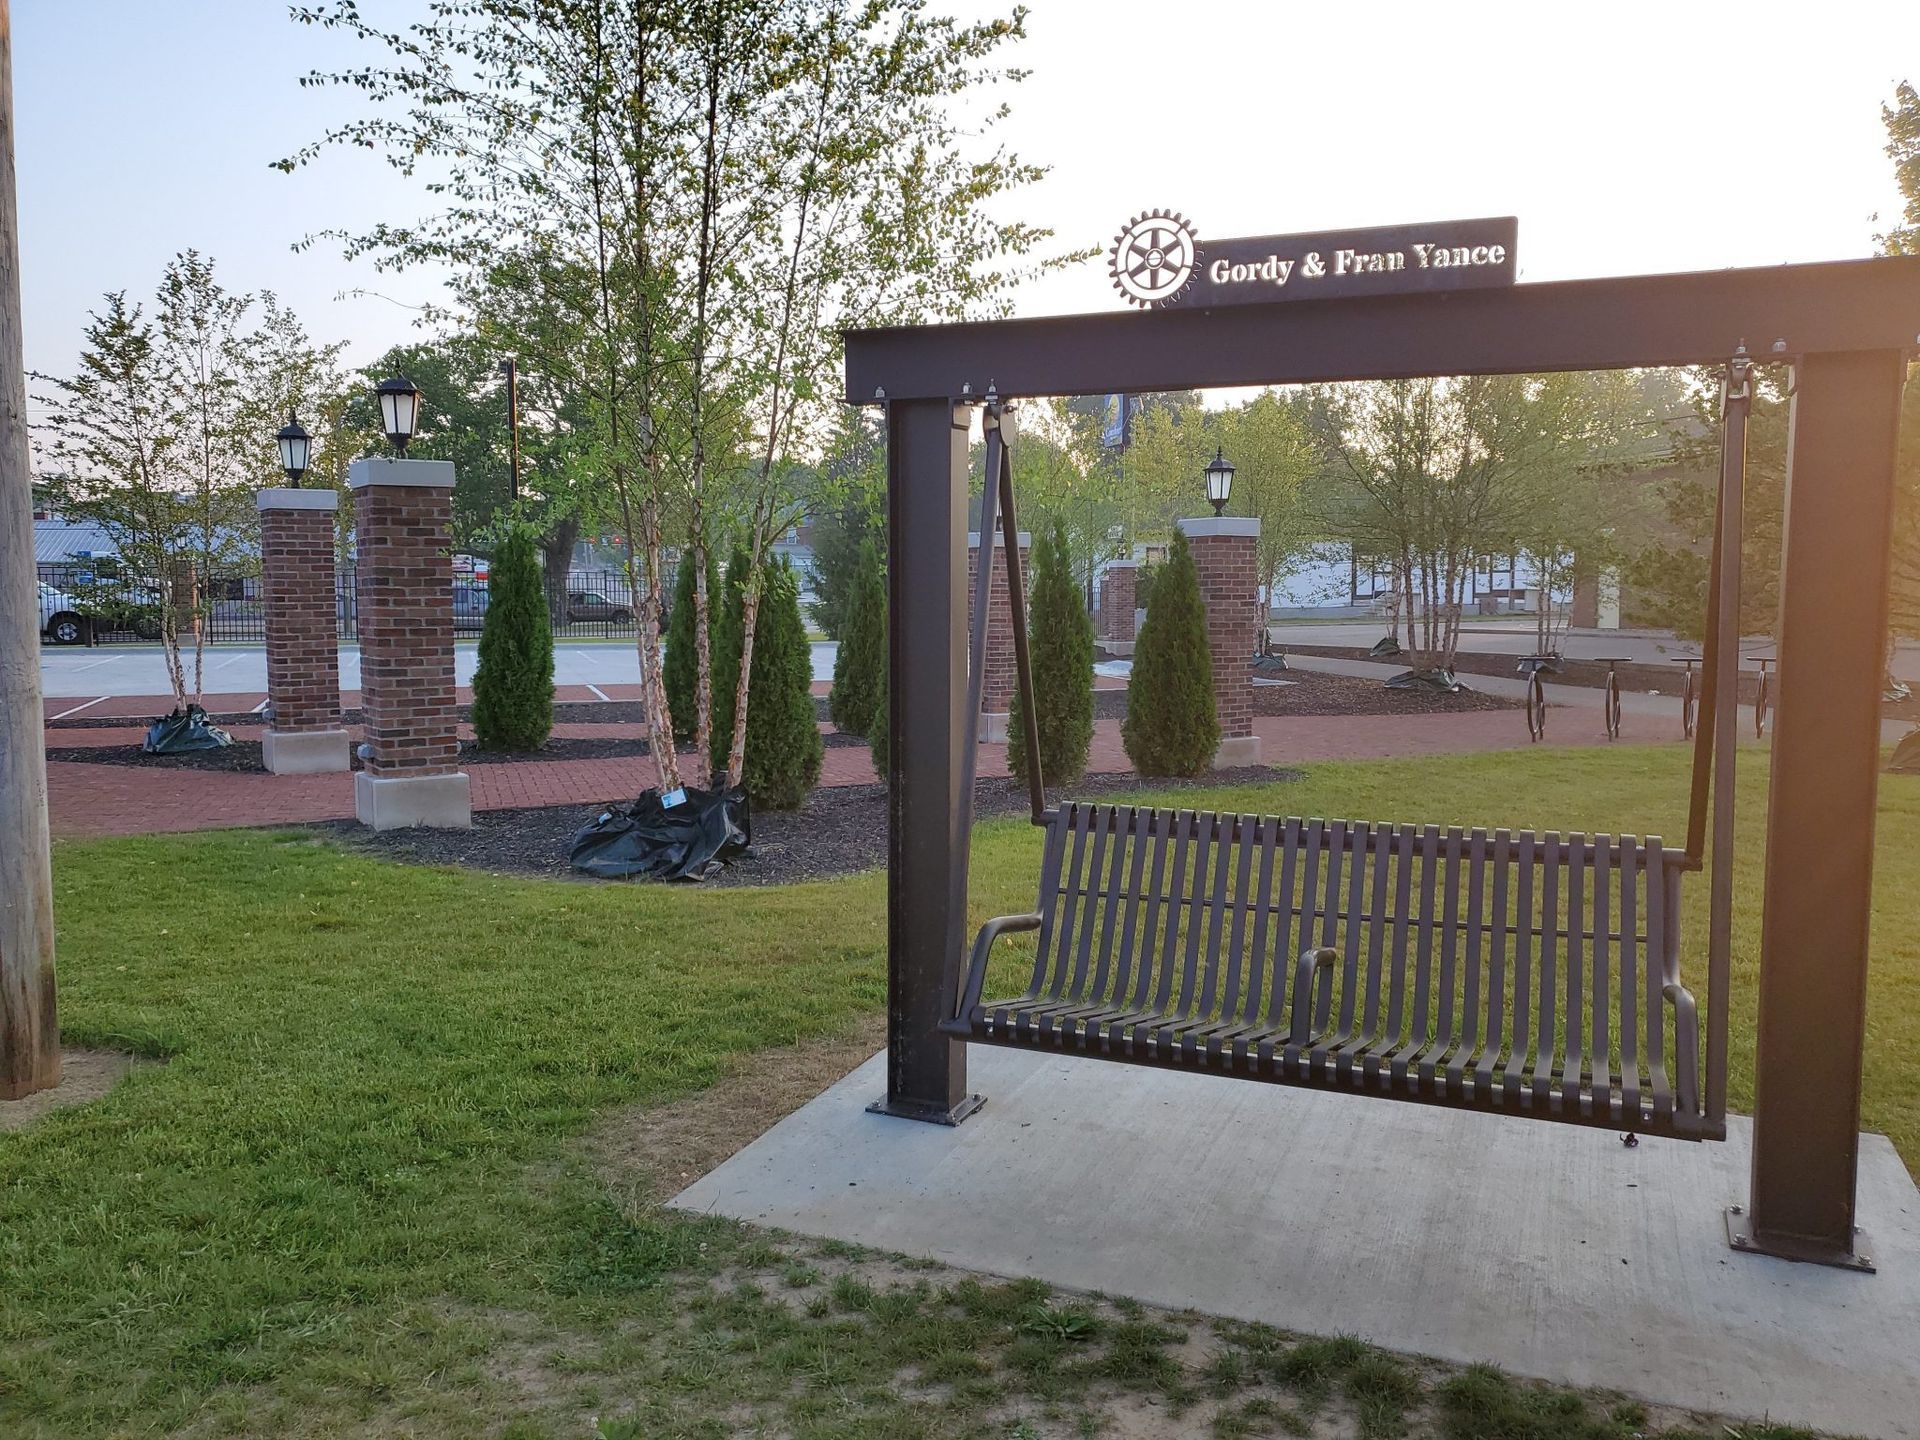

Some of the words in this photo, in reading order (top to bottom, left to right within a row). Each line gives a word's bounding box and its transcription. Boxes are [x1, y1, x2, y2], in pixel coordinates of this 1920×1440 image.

[1209, 255, 1294, 286] Gordy
[1302, 250, 1326, 277] &
[1335, 247, 1405, 275] Fran
[1413, 242, 1506, 268] Yance
